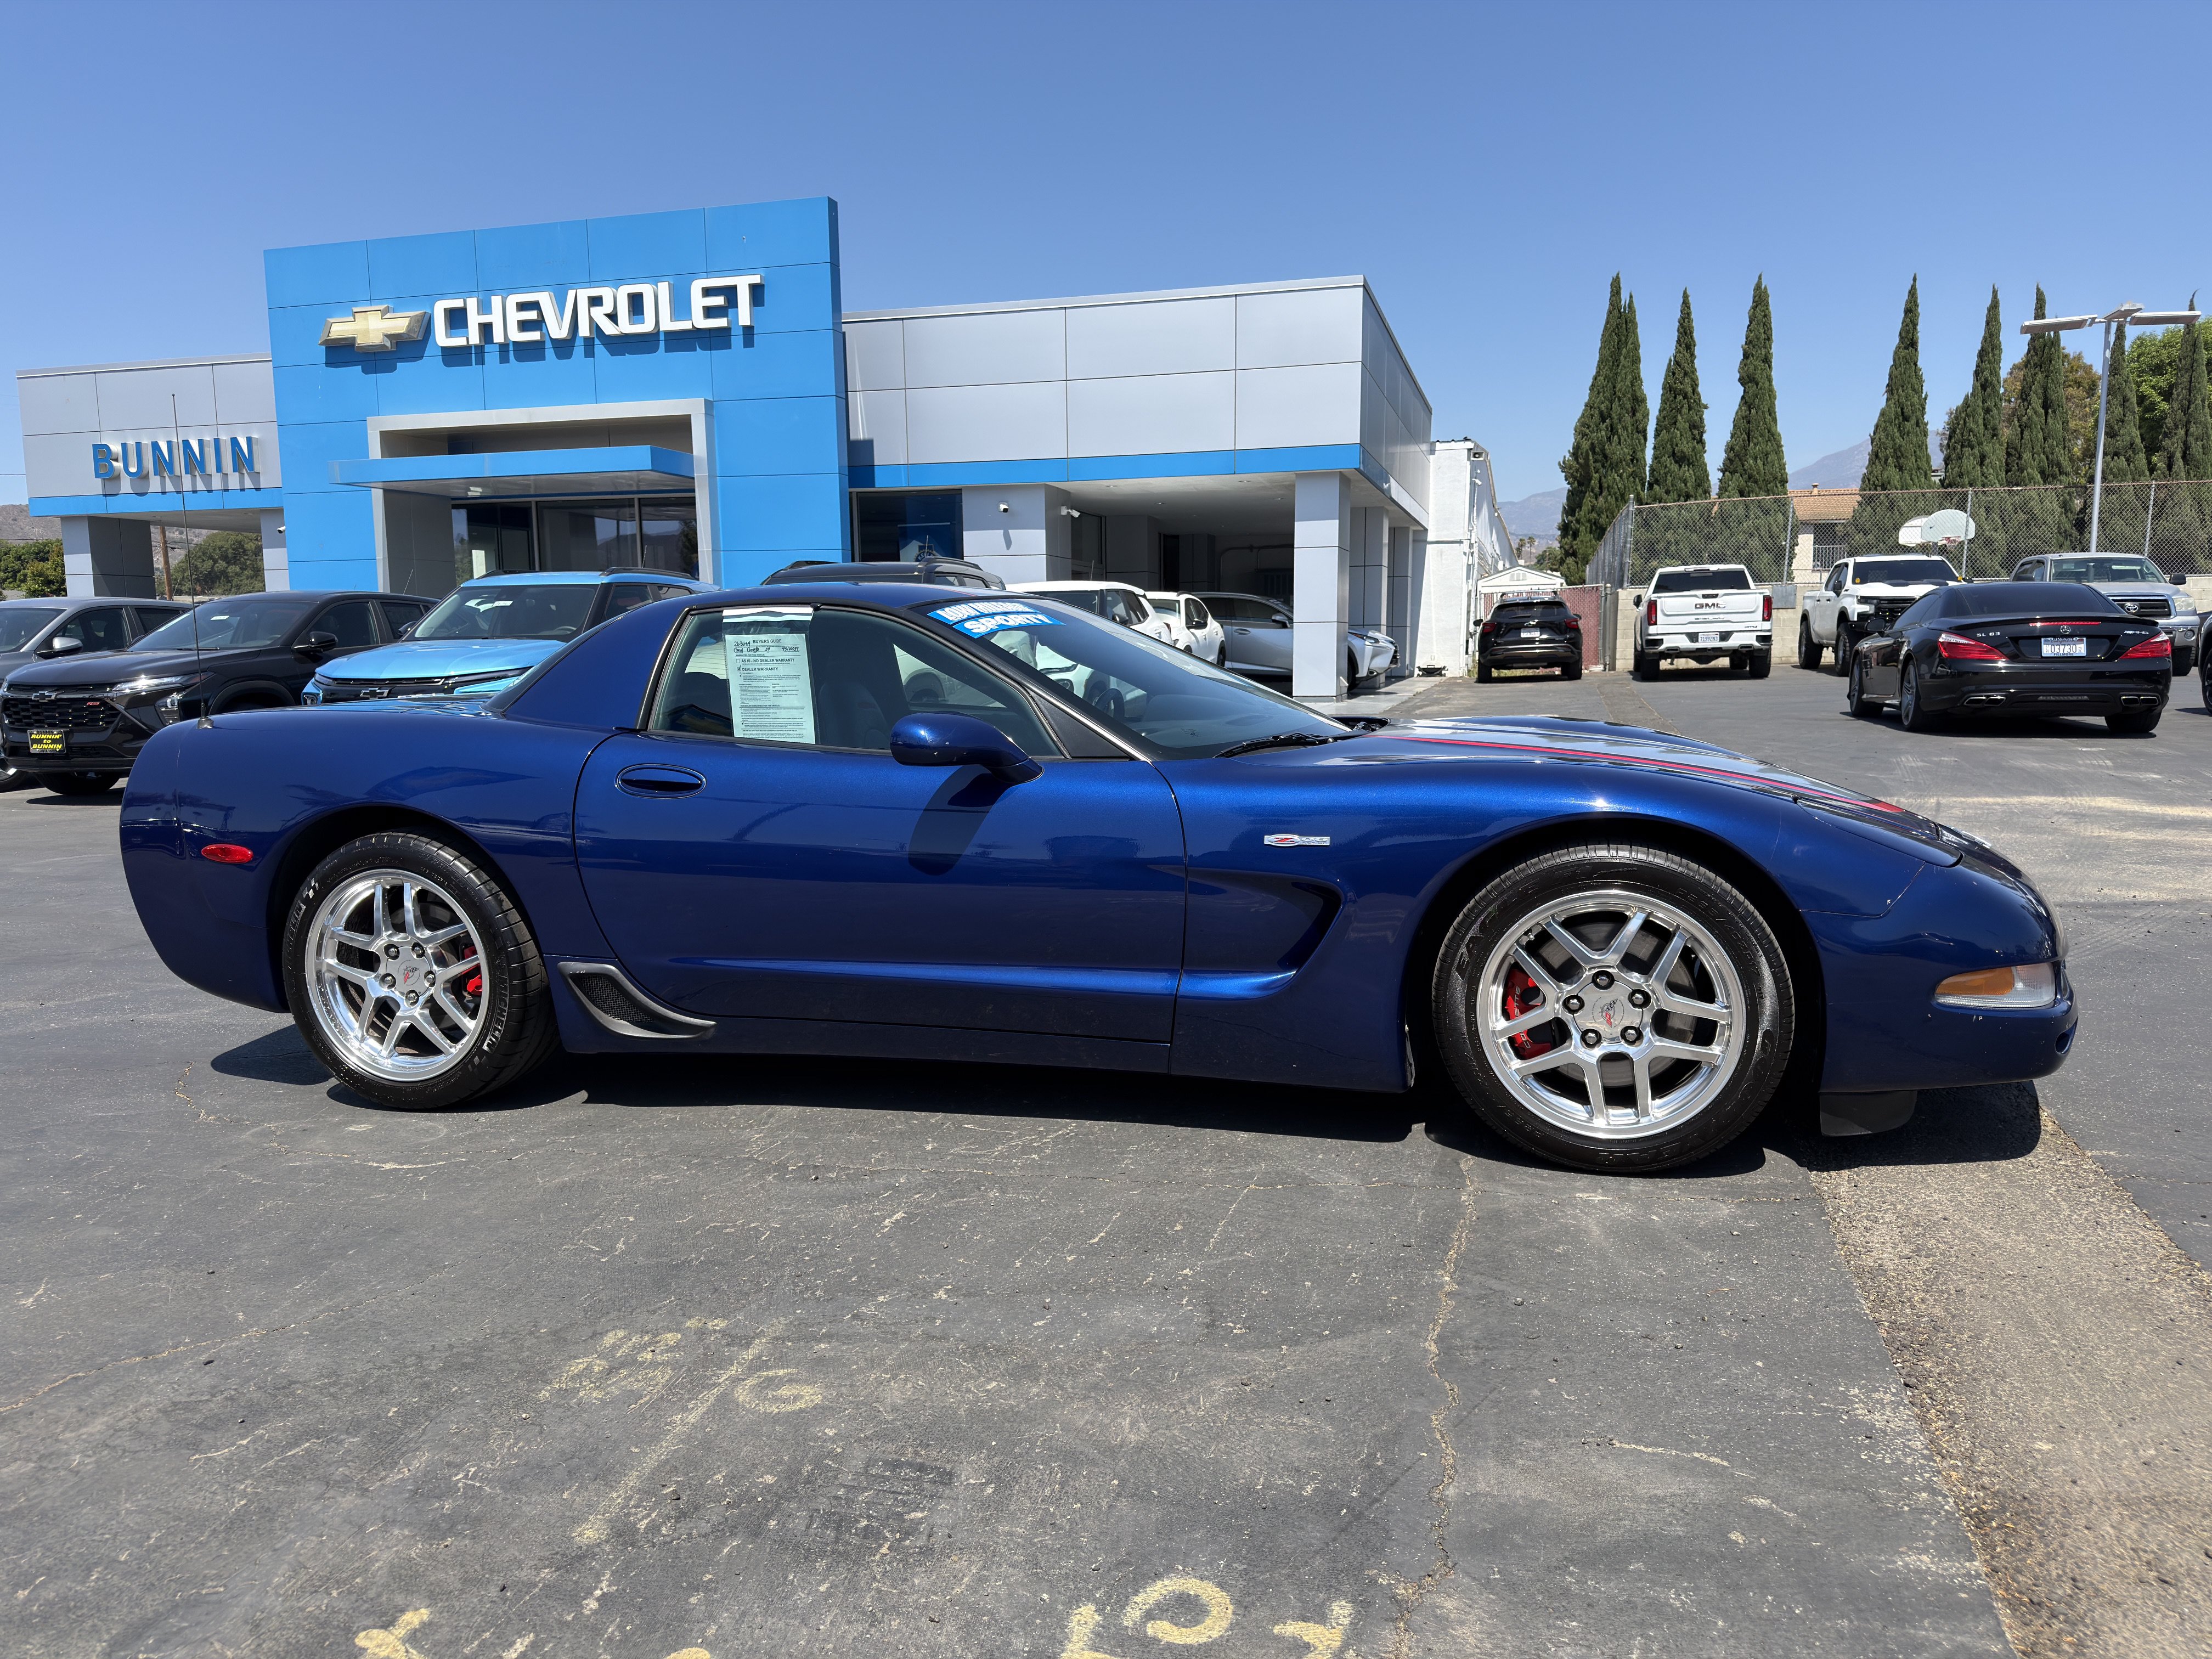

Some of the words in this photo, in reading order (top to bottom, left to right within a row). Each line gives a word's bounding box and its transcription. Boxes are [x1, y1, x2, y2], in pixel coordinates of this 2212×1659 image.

[433, 274, 764, 347] CHEVROLET
[92, 436, 259, 479] BUNNIN
[1694, 601, 1726, 610] GMC
[963, 613, 1053, 634] SPORTY
[2051, 644, 2077, 653] 03730
[1514, 986, 1531, 1048] COETTE
